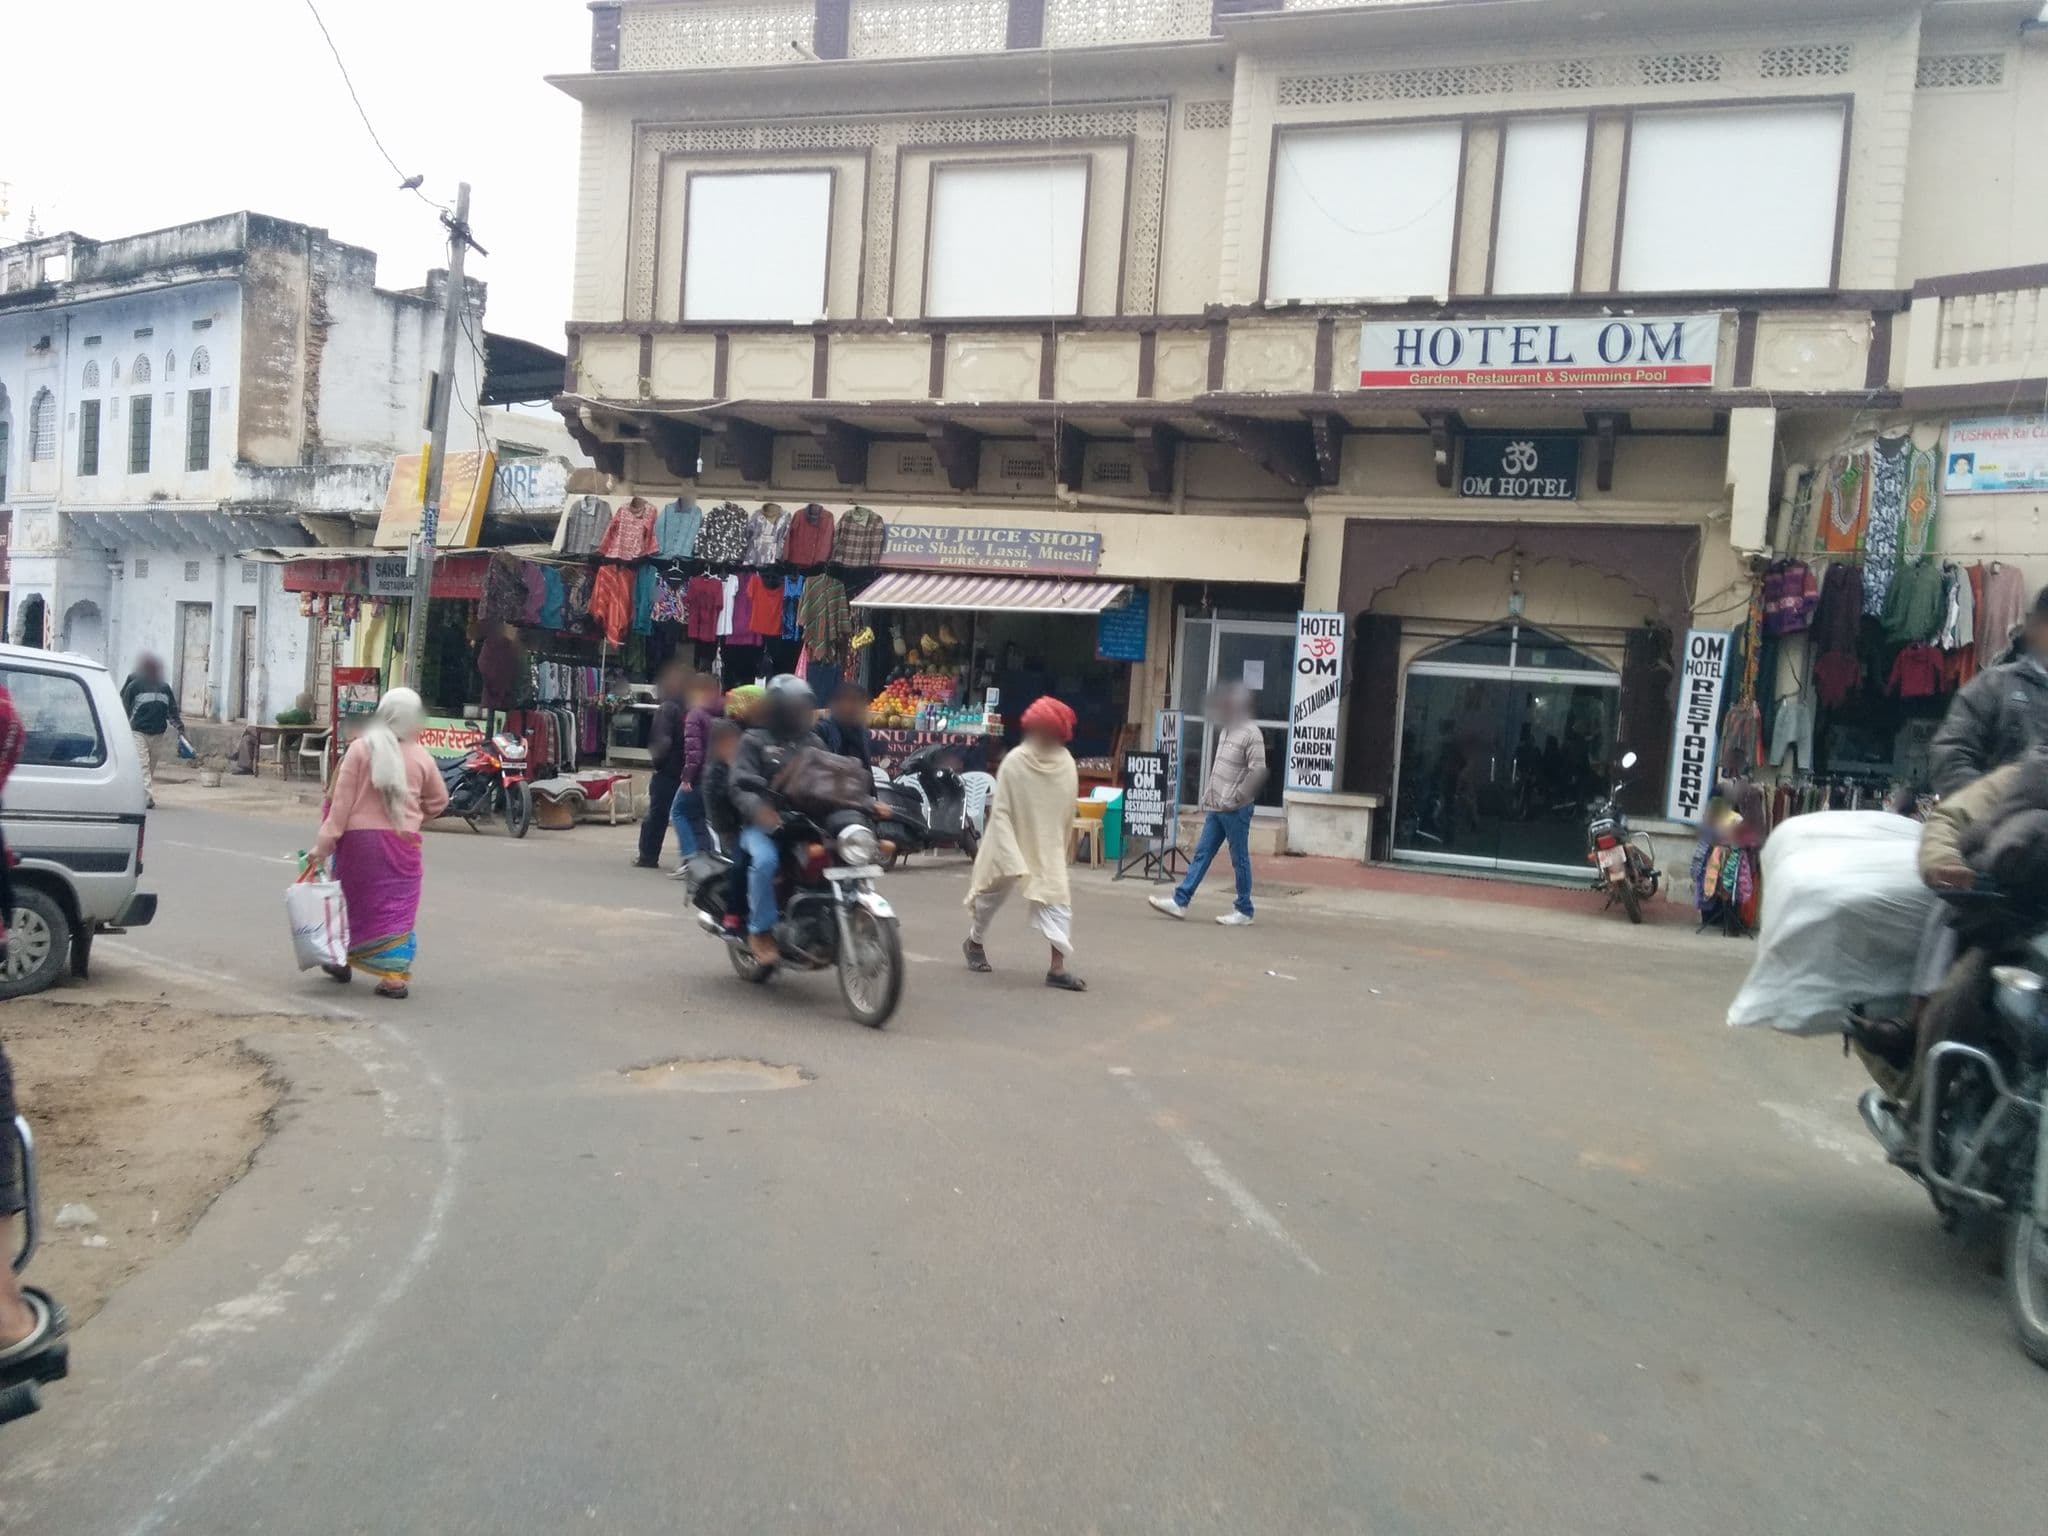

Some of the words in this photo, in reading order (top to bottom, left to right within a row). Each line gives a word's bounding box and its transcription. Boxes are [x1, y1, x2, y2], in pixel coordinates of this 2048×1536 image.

[1393, 325, 1575, 367] HOTEL
[1597, 321, 1686, 363] OM
[1466, 371, 1541, 385] Restaurant
[1544, 371, 1555, 383] &
[1559, 369, 1632, 385] Swimming
[1635, 369, 1667, 382] Pool
[1462, 477, 1493, 496] OM
[1499, 477, 1572, 498] HOTEL
[887, 526, 949, 540] SONU
[953, 528, 1022, 543] JUICE
[1028, 531, 1095, 547] SHOP
[883, 540, 924, 554] Juice
[928, 541, 979, 557] Shake,
[986, 545, 1032, 560] Lassi,
[1038, 545, 1093, 562] Muesli
[939, 557, 977, 566] PURE
[978, 558, 990, 567] &
[991, 559, 1029, 568] SAFE
[1301, 617, 1342, 636] HOTEL
[1691, 637, 1724, 660] OM
[1297, 658, 1337, 676] OM
[1685, 660, 1722, 678] HOTEL
[1294, 679, 1342, 723] RESTAURANT
[1162, 715, 1176, 738] OM
[1293, 726, 1336, 741] NATURAL
[1294, 741, 1332, 756] GARDEN
[1677, 679, 1715, 818] RESTAURANT
[1127, 756, 1163, 774] HOTEL
[1290, 756, 1334, 772] SWIMMING
[1133, 773, 1156, 789] OM
[1298, 773, 1323, 787] POOL
[1126, 789, 1161, 802] GARDEN
[1124, 800, 1165, 813] RESTAURANT
[1124, 811, 1163, 825] SWIMMING
[1131, 823, 1153, 836] POOL
